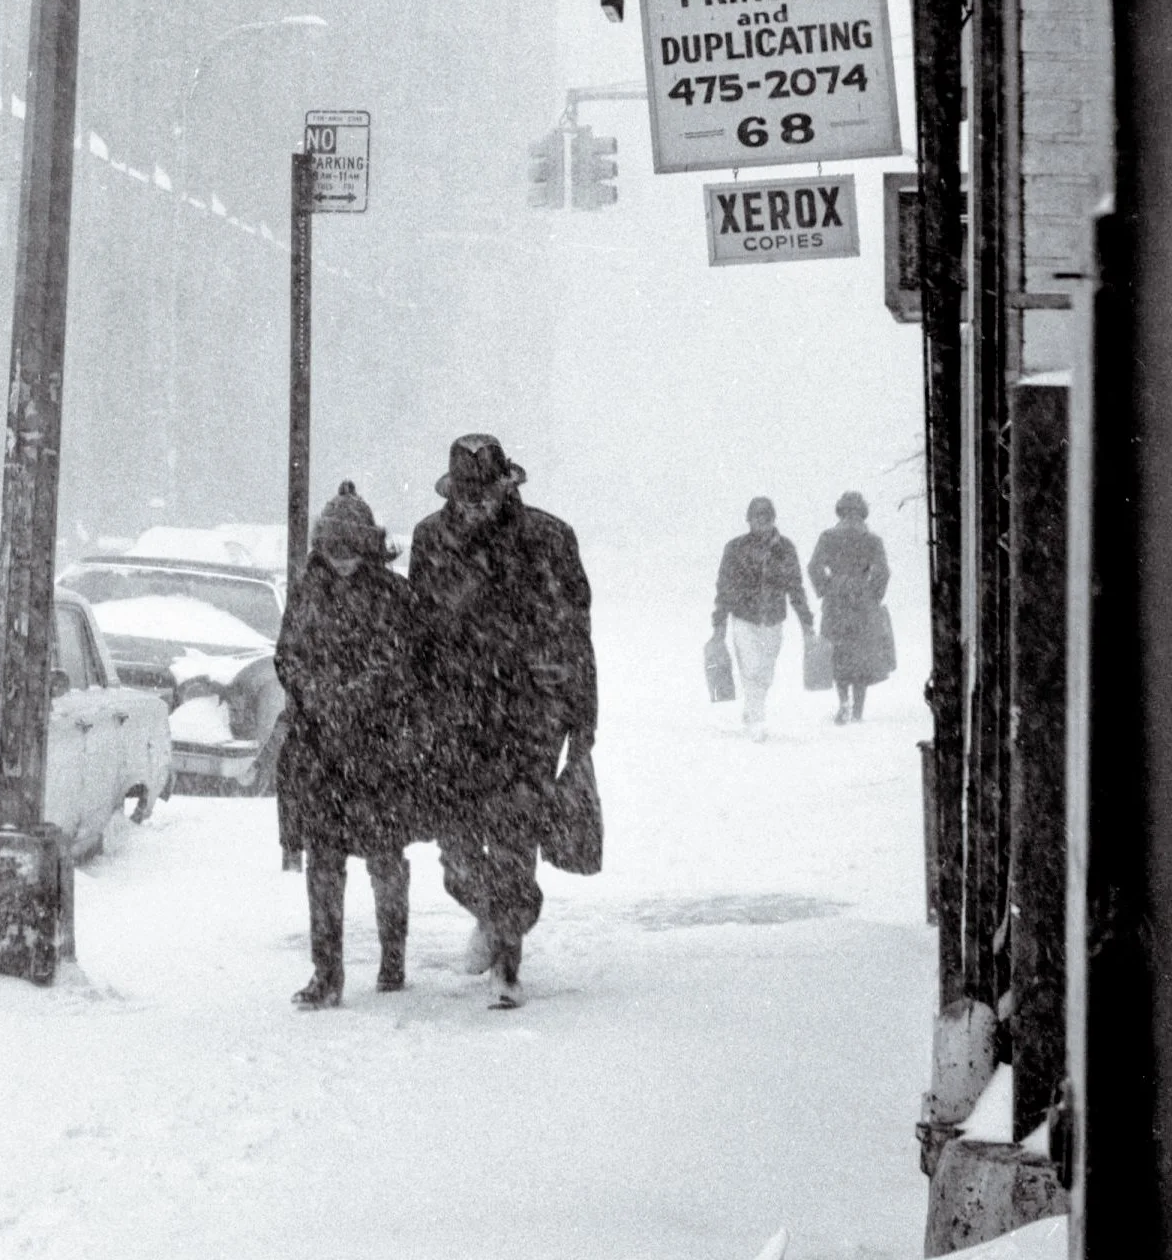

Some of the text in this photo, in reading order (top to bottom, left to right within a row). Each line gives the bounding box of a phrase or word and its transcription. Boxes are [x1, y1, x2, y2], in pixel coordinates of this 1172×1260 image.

[737, 4, 789, 26] and
[661, 19, 873, 65] DUPLICATING
[668, 64, 868, 106] 475-2074
[306, 128, 335, 150] NO
[717, 186, 843, 234] XEROX
[742, 232, 824, 252] COPIES
